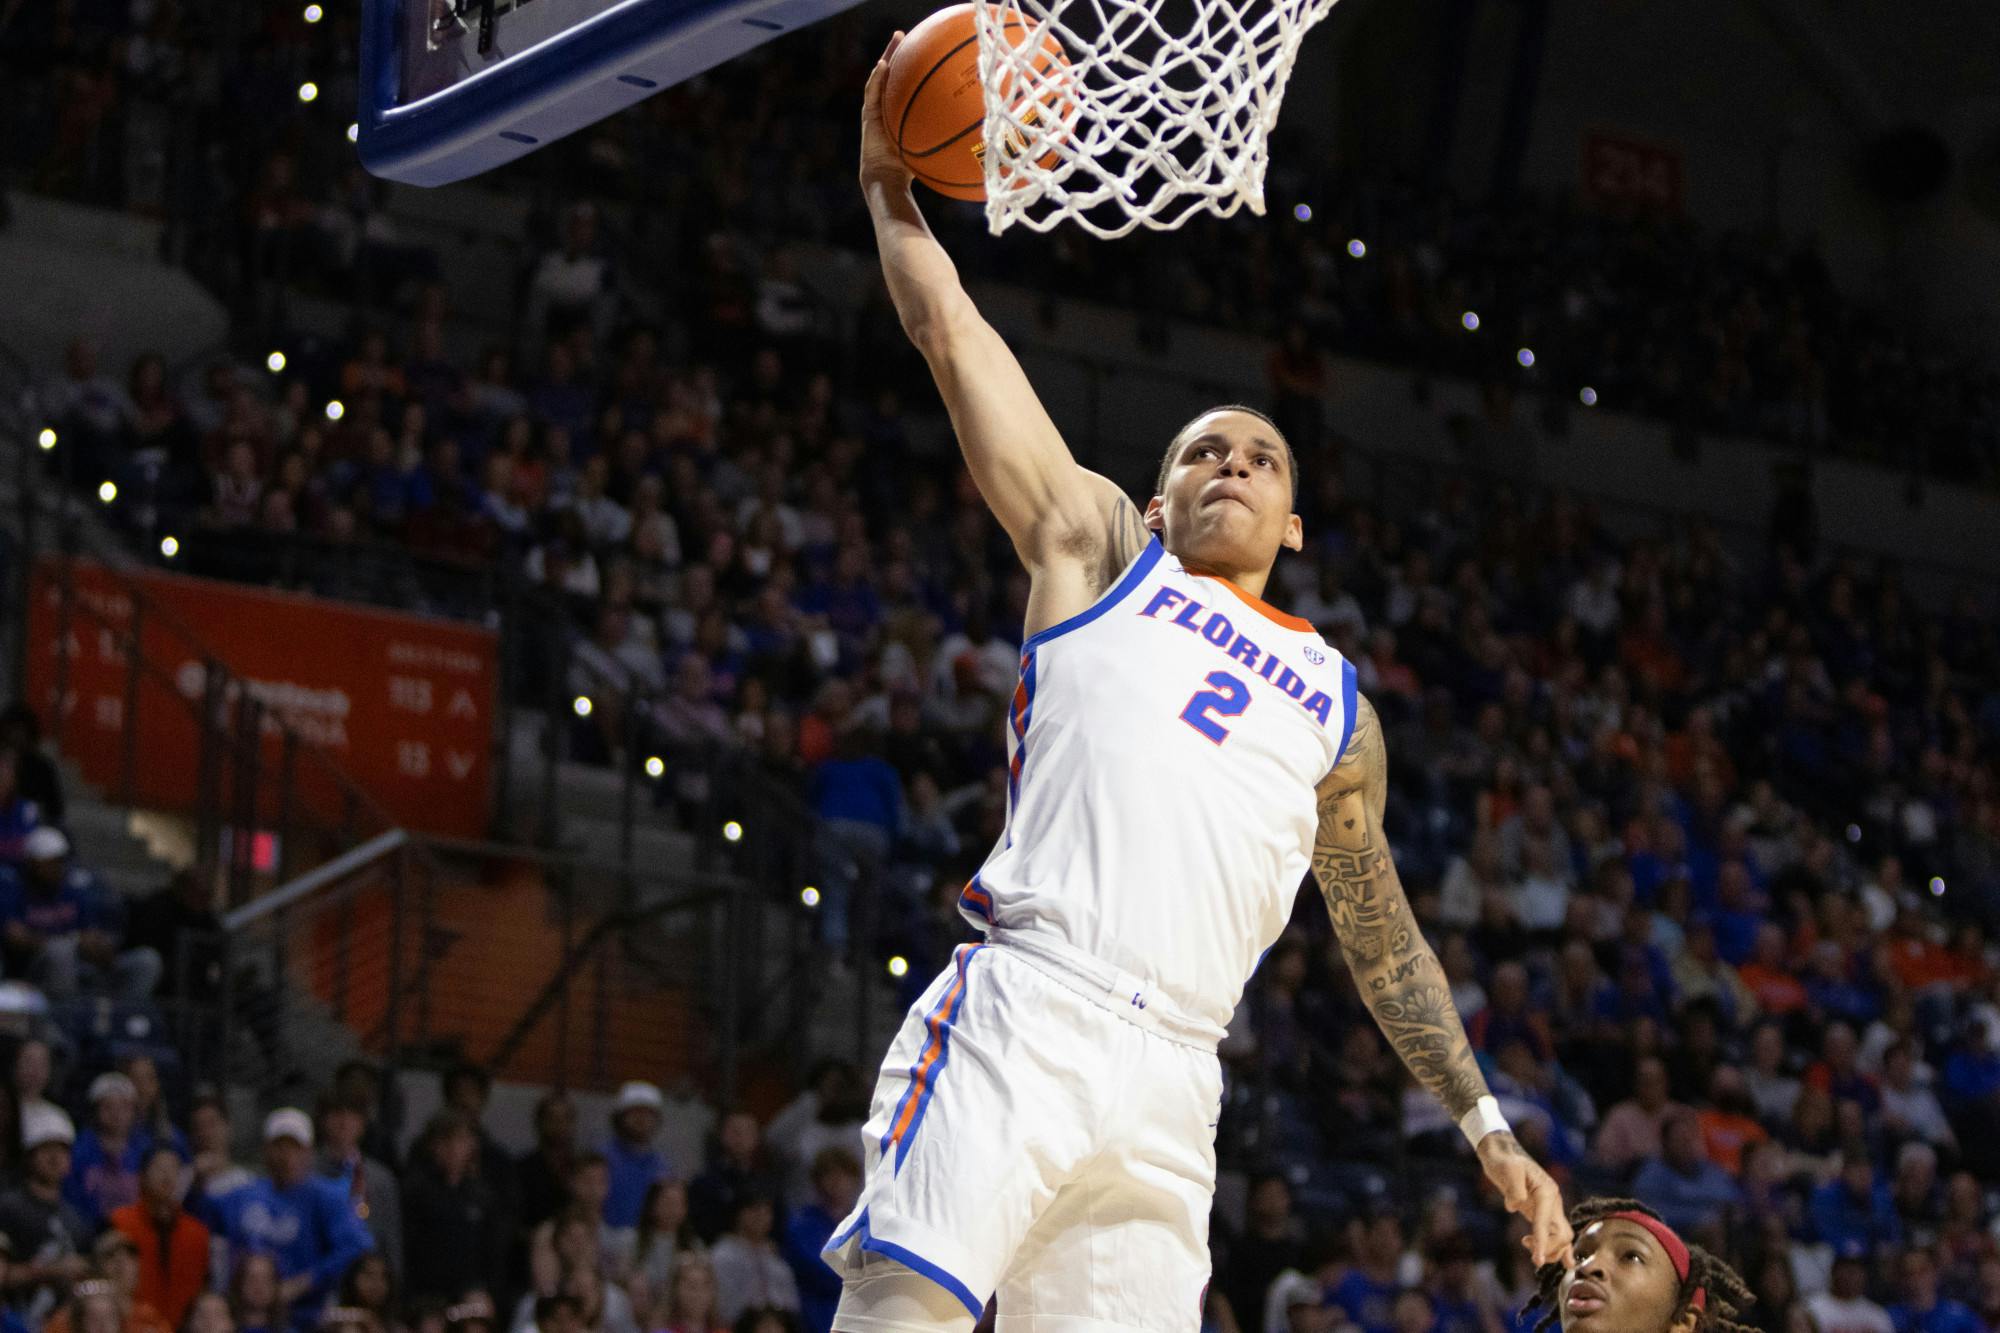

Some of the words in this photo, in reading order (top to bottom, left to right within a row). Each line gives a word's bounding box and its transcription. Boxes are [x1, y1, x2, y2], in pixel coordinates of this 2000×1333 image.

[1136, 584, 1334, 728] FLORIDA
[1178, 670, 1253, 747] 2
[1312, 847, 1376, 882] BET
